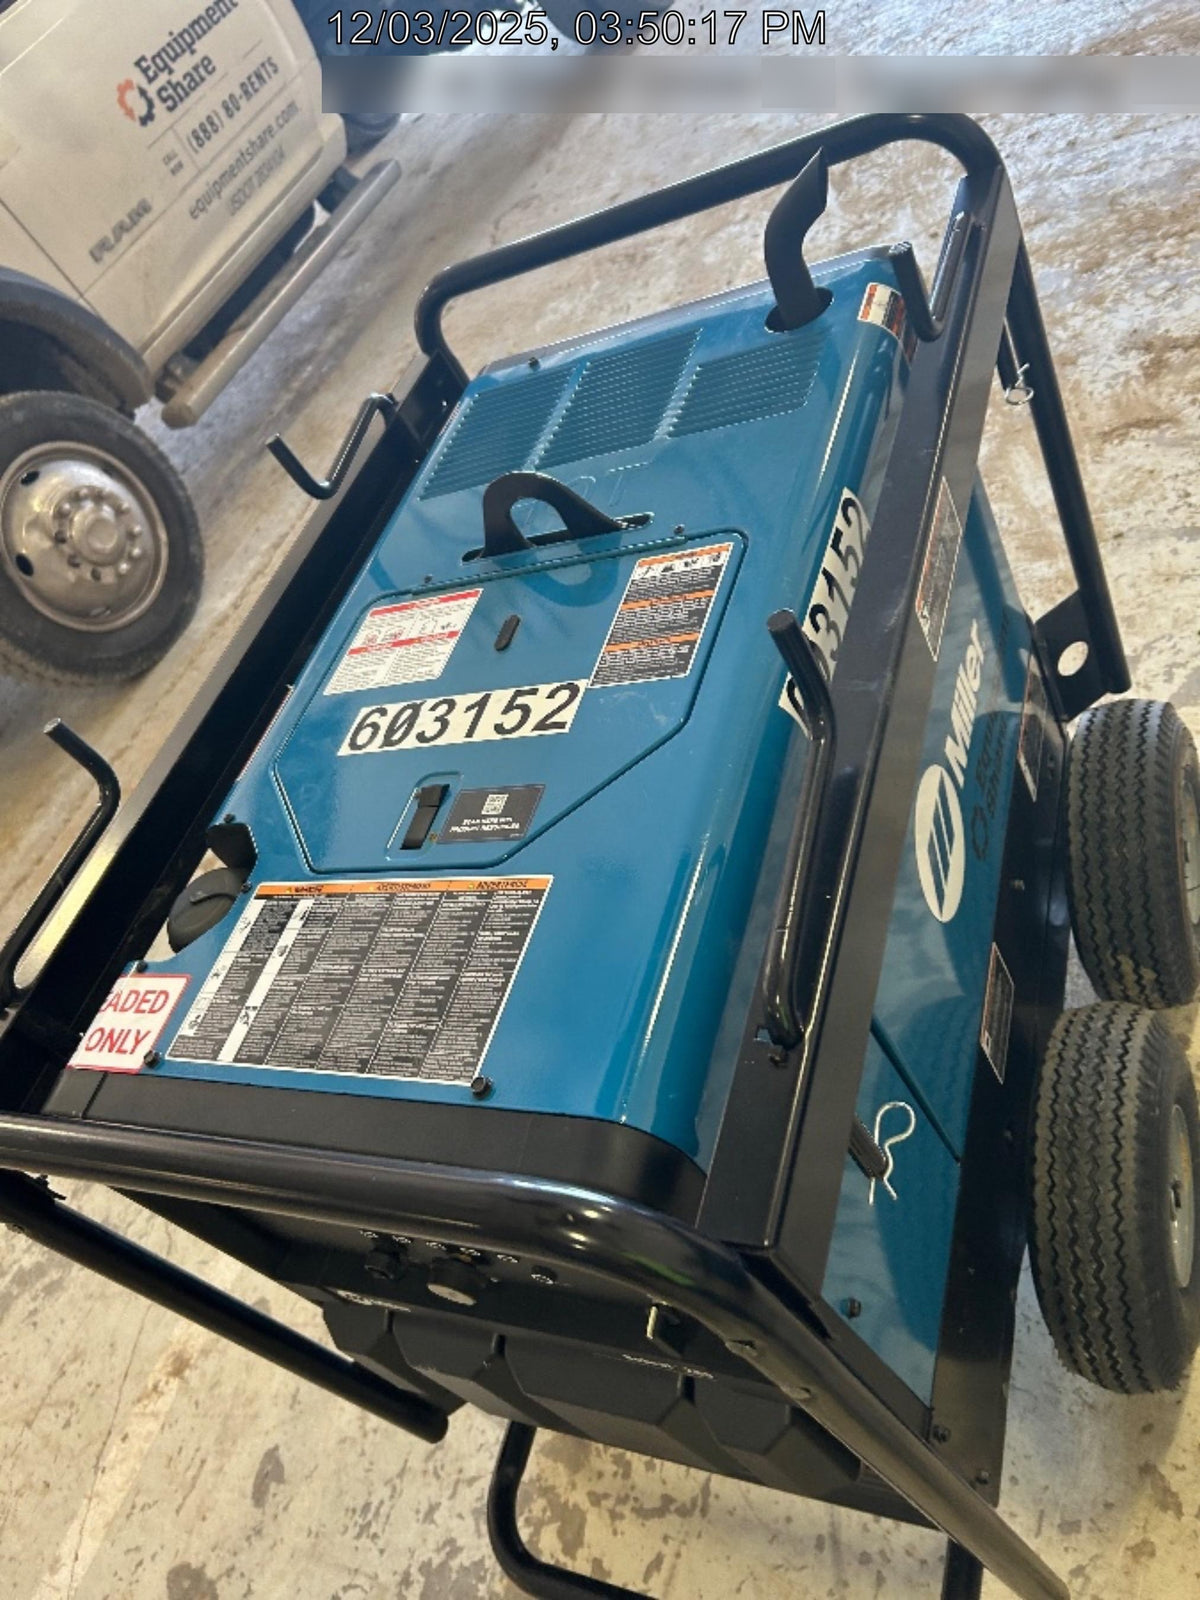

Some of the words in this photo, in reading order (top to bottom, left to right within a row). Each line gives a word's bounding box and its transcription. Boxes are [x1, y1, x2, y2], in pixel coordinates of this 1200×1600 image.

[133, 0, 239, 84] Equipment
[156, 55, 216, 112] Share
[186, 110, 224, 154] (888)
[222, 56, 279, 118] 80-RENTS
[189, 101, 299, 220] equipmentshare.com
[348, 682, 580, 750] 603152
[944, 618, 985, 789] Miller
[85, 1027, 151, 1054] ONLY
